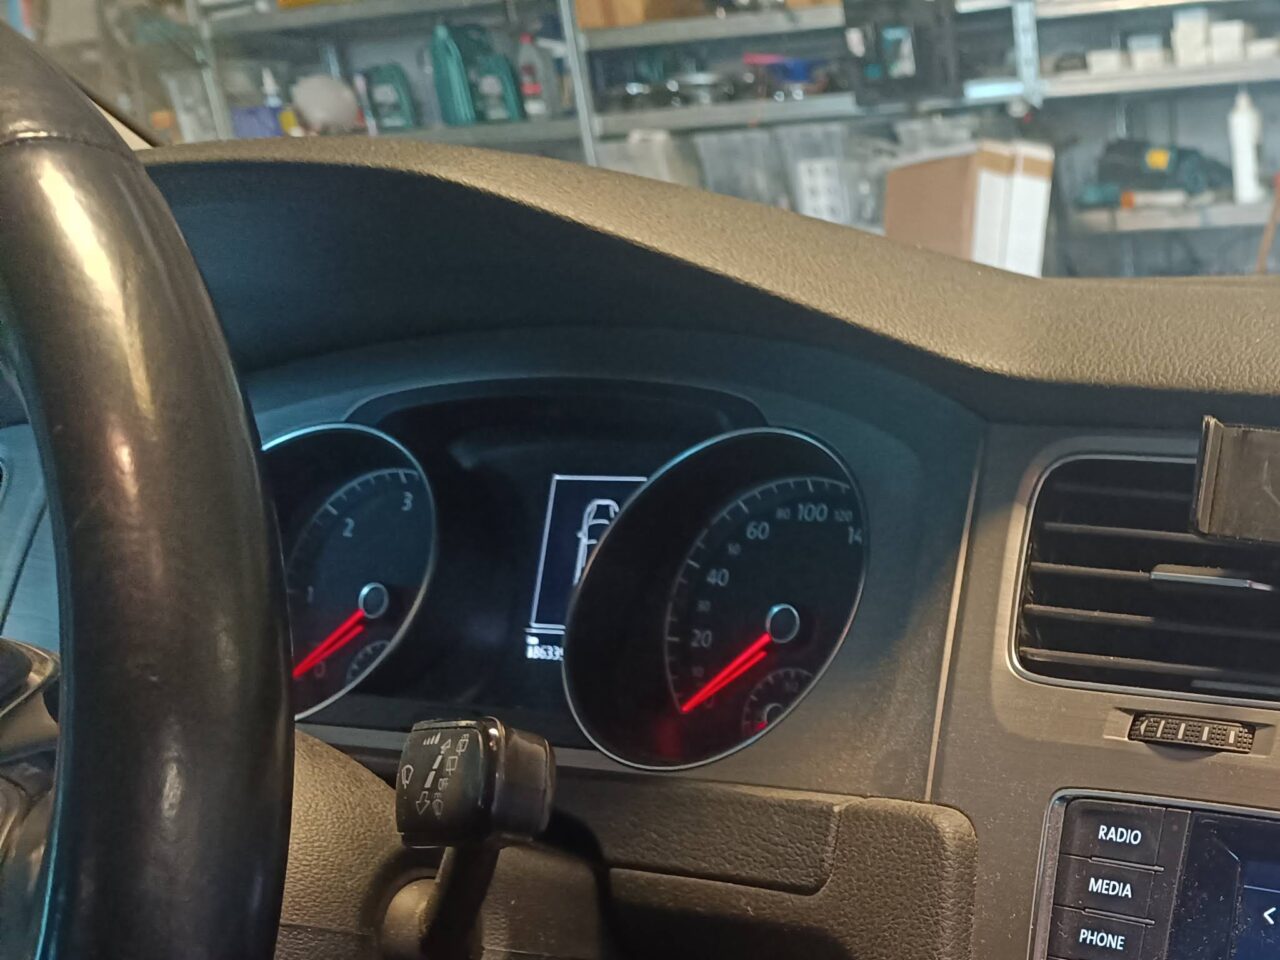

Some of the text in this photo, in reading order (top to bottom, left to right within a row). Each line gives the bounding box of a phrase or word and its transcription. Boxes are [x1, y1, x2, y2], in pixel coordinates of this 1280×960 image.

[401, 491, 414, 511] 3
[798, 503, 829, 522] 100
[342, 518, 355, 538] 2
[746, 521, 770, 540] 60
[848, 526, 864, 545] 14
[706, 568, 730, 587] 40
[691, 629, 712, 648] 20
[1098, 825, 1142, 845] RADIO
[1088, 877, 1133, 899] MEDIA
[1079, 929, 1126, 950] PHONE
